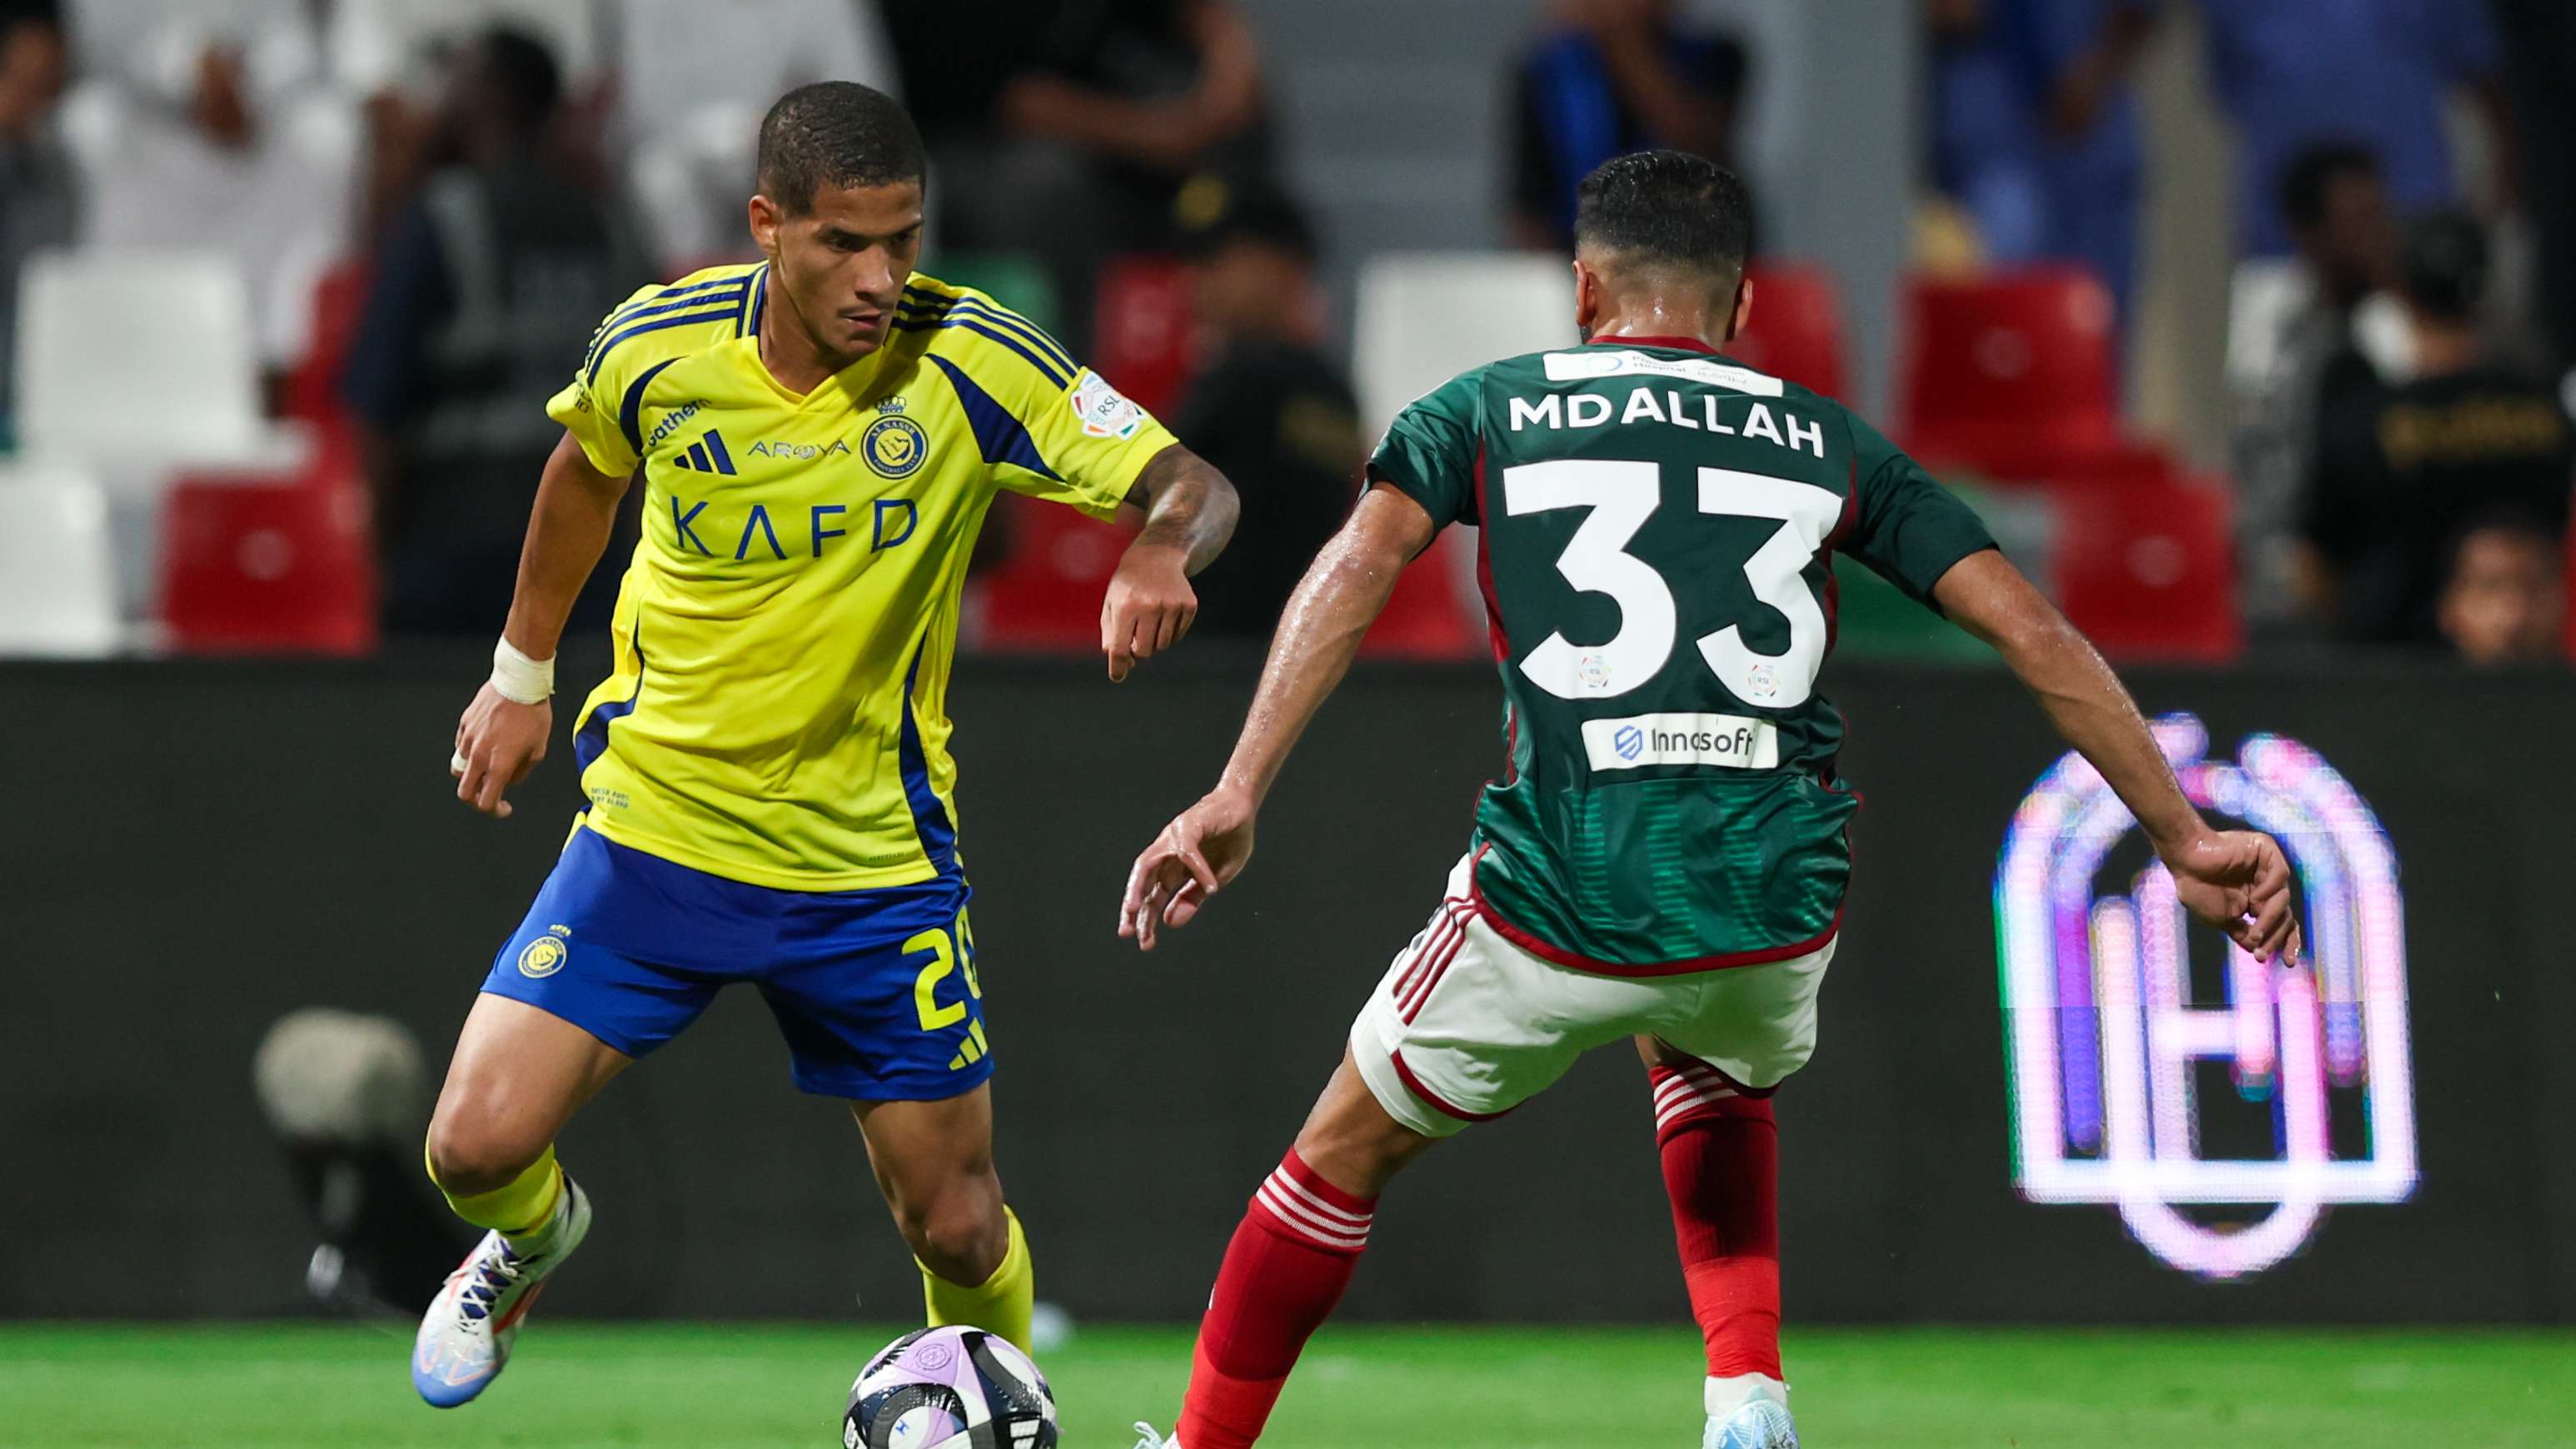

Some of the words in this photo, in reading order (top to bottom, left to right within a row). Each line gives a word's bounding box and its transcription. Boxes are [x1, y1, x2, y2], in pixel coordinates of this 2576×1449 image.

[1098, 395, 1121, 416] RSL
[1503, 460, 1844, 709] 33
[901, 904, 982, 1032] 20
